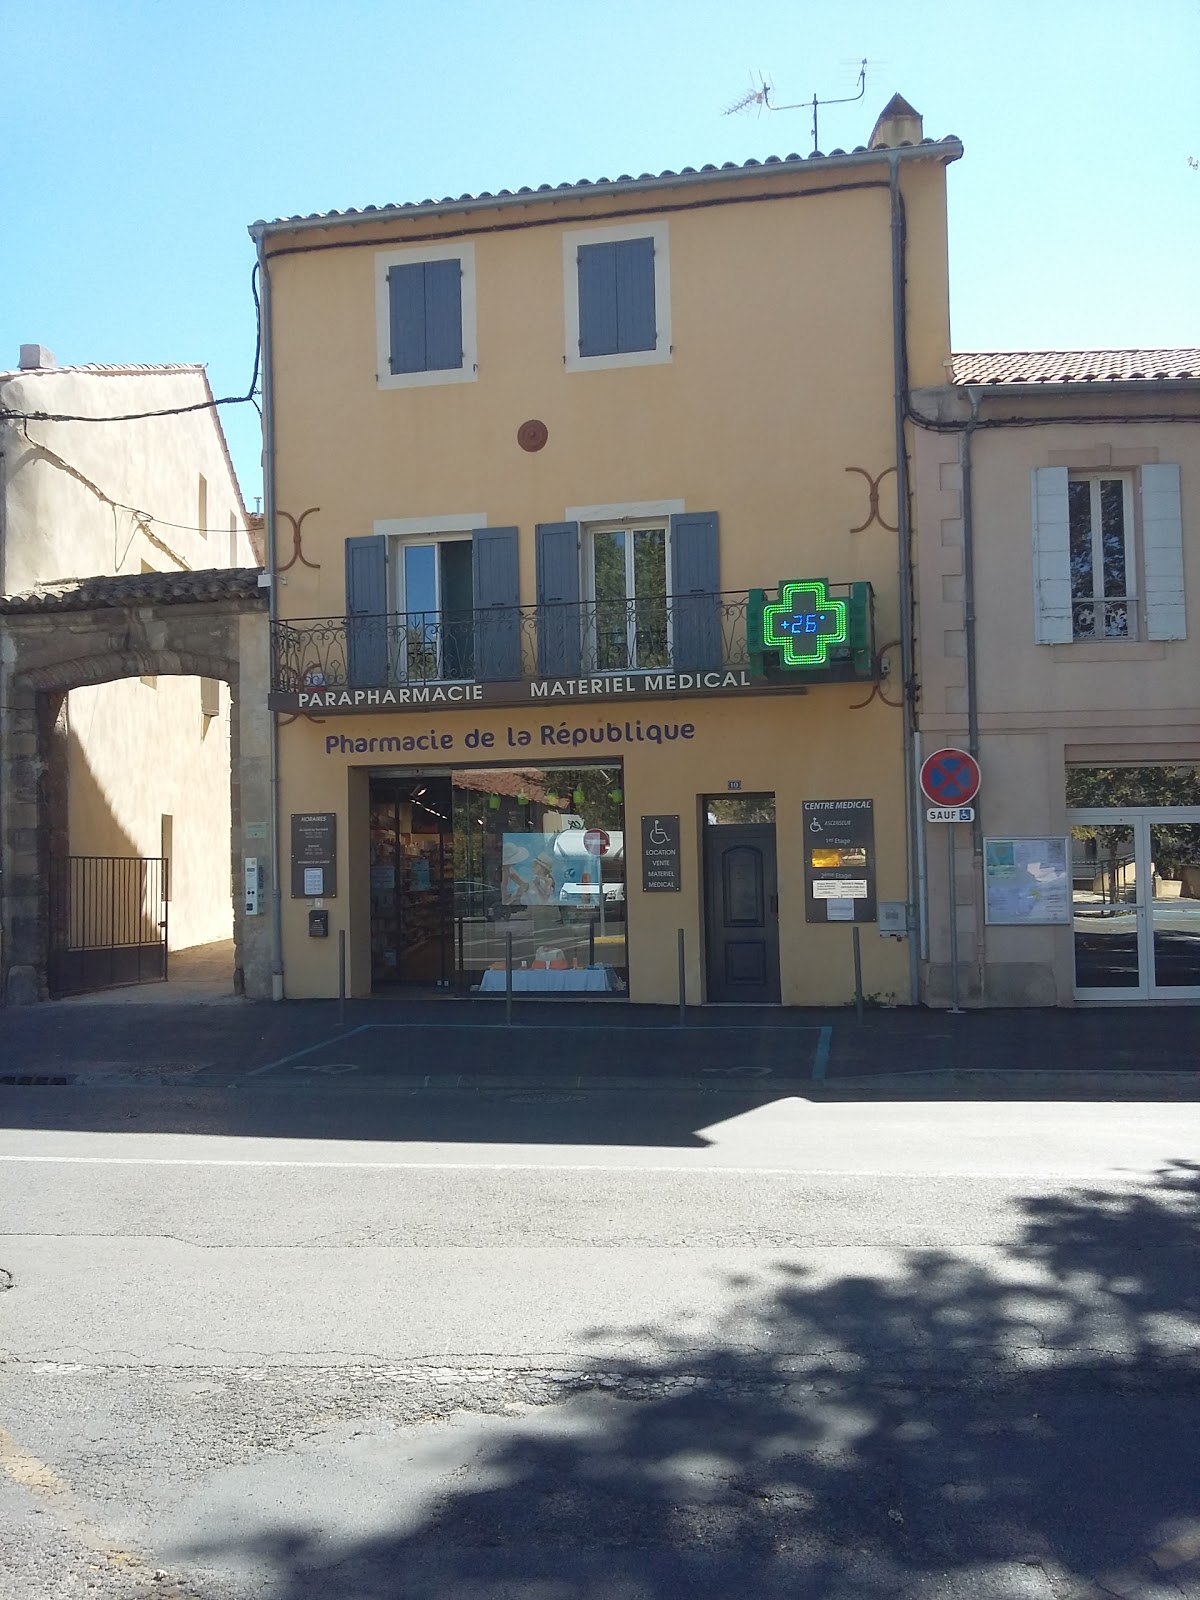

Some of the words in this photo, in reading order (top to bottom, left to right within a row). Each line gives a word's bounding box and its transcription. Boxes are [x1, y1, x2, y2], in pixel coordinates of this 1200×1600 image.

[530, 676, 636, 697] MATERIEL
[643, 671, 751, 691] MEDICAL
[298, 684, 484, 708] PARAPHARMACIE
[325, 729, 453, 754] Pharmacie
[465, 727, 495, 749] de
[507, 726, 532, 747] la
[540, 720, 695, 747] République
[804, 802, 834, 810] CENTRE
[835, 800, 872, 809] MEDICAL
[929, 810, 957, 820] SAUF
[834, 837, 851, 845] Etage
